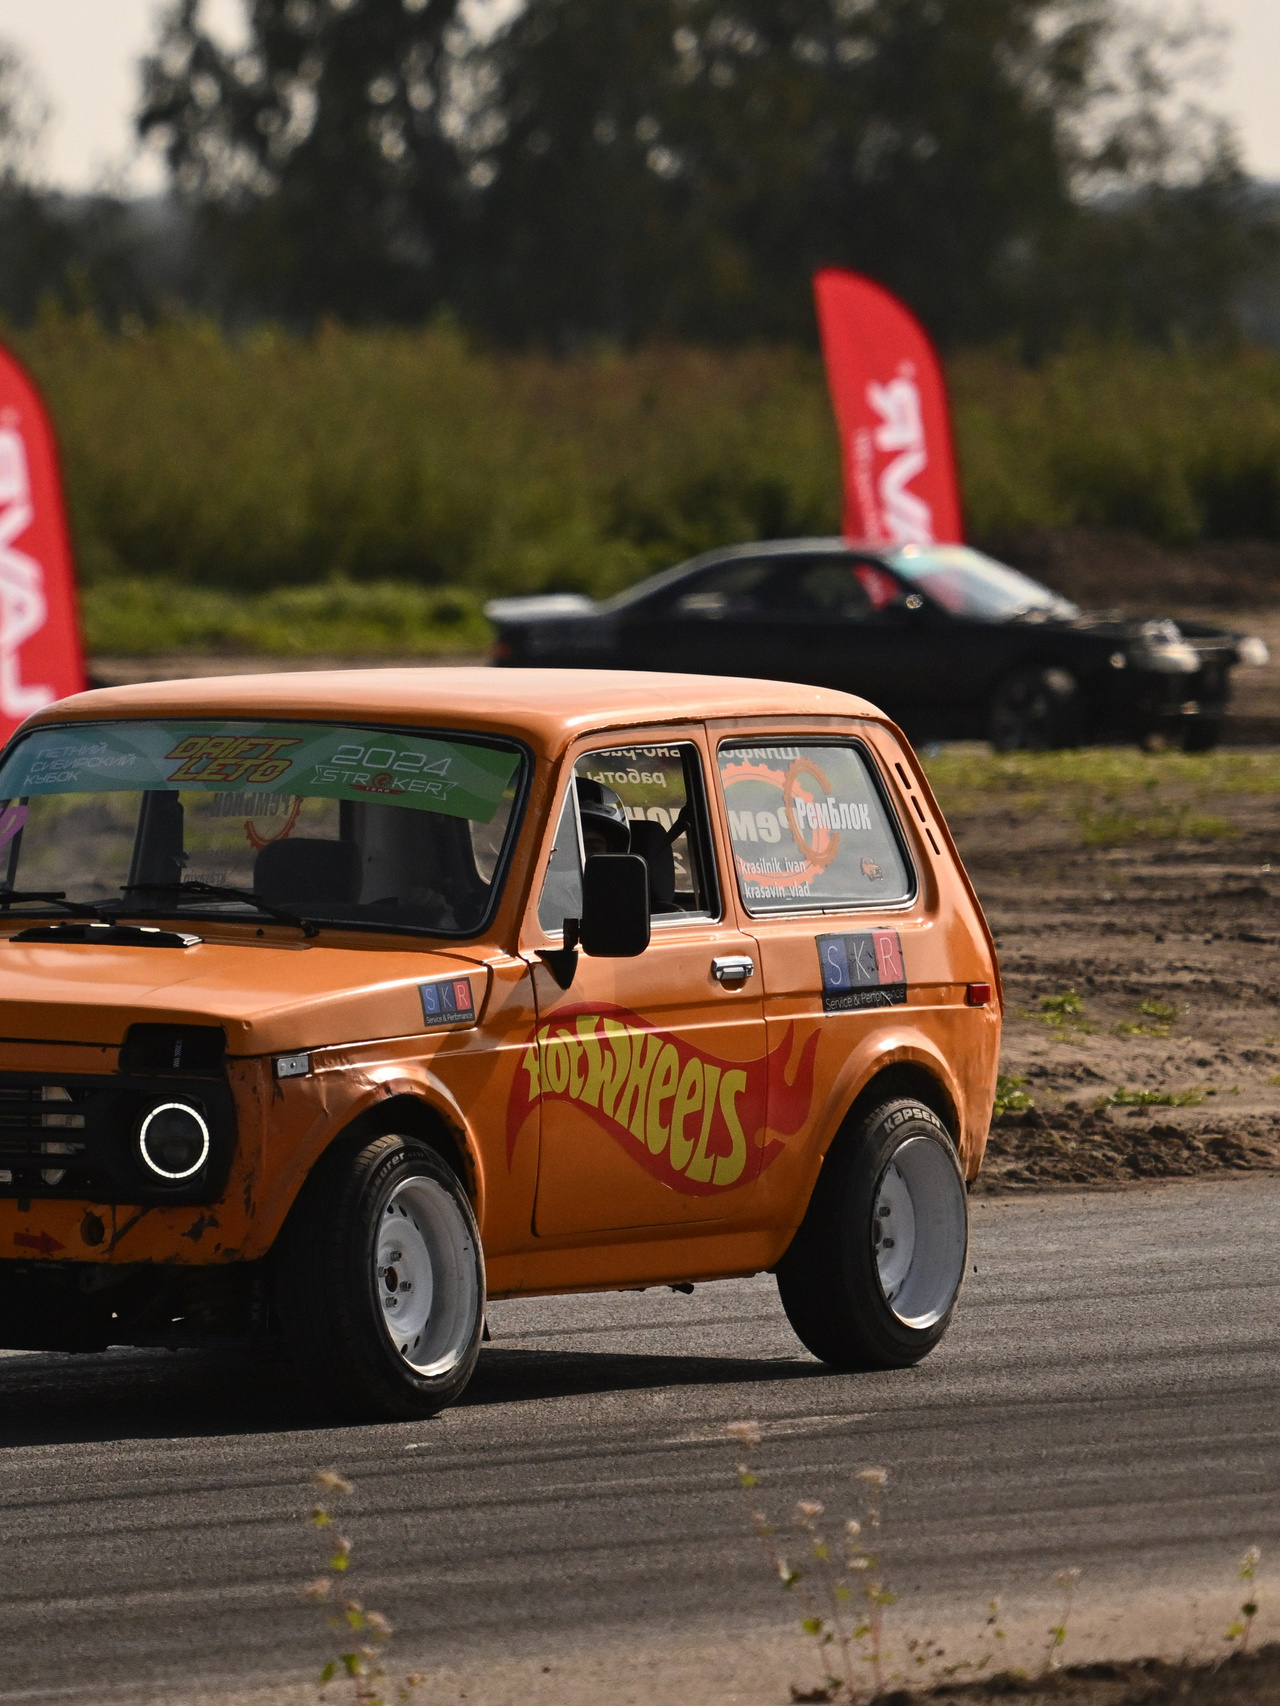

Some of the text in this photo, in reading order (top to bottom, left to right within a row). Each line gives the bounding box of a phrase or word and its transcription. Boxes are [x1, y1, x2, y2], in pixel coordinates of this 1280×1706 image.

[36, 742, 108, 759] ЛЕТНИЙ
[164, 735, 304, 759] DRIFT
[30, 753, 137, 772] СИБИРСКИЙ
[167, 757, 293, 783] LETO
[331, 745, 452, 776] 2024
[23, 771, 81, 787] КУБОК
[744, 881, 810, 900] krasavin_vlad
[826, 995, 852, 1011] Service
